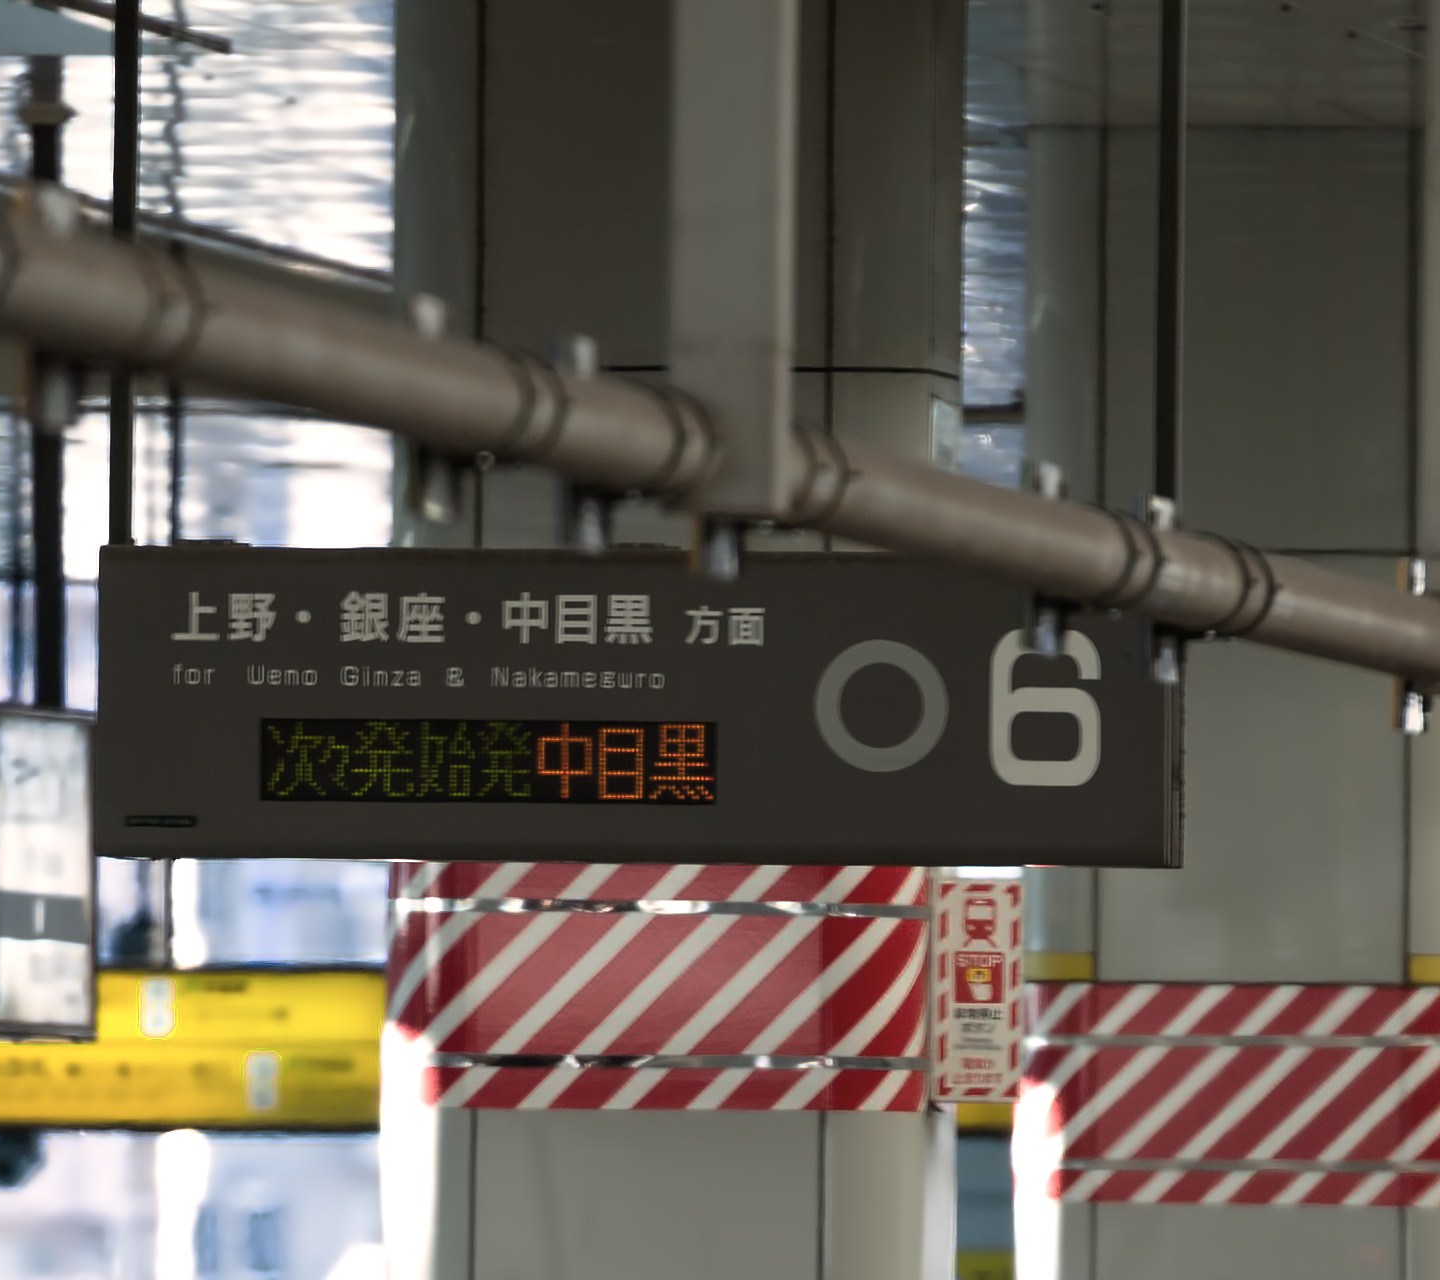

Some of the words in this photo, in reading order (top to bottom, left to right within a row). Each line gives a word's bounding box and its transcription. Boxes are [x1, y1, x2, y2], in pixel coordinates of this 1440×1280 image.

[171, 591, 653, 644] 上野・銀座・中目黒
[684, 606, 766, 646] 方面
[172, 664, 216, 686] for
[247, 664, 318, 686] Ueno
[340, 665, 422, 687] Ginza
[445, 667, 464, 688] &
[491, 666, 666, 690] Nakameguro
[989, 627, 1102, 787] 6
